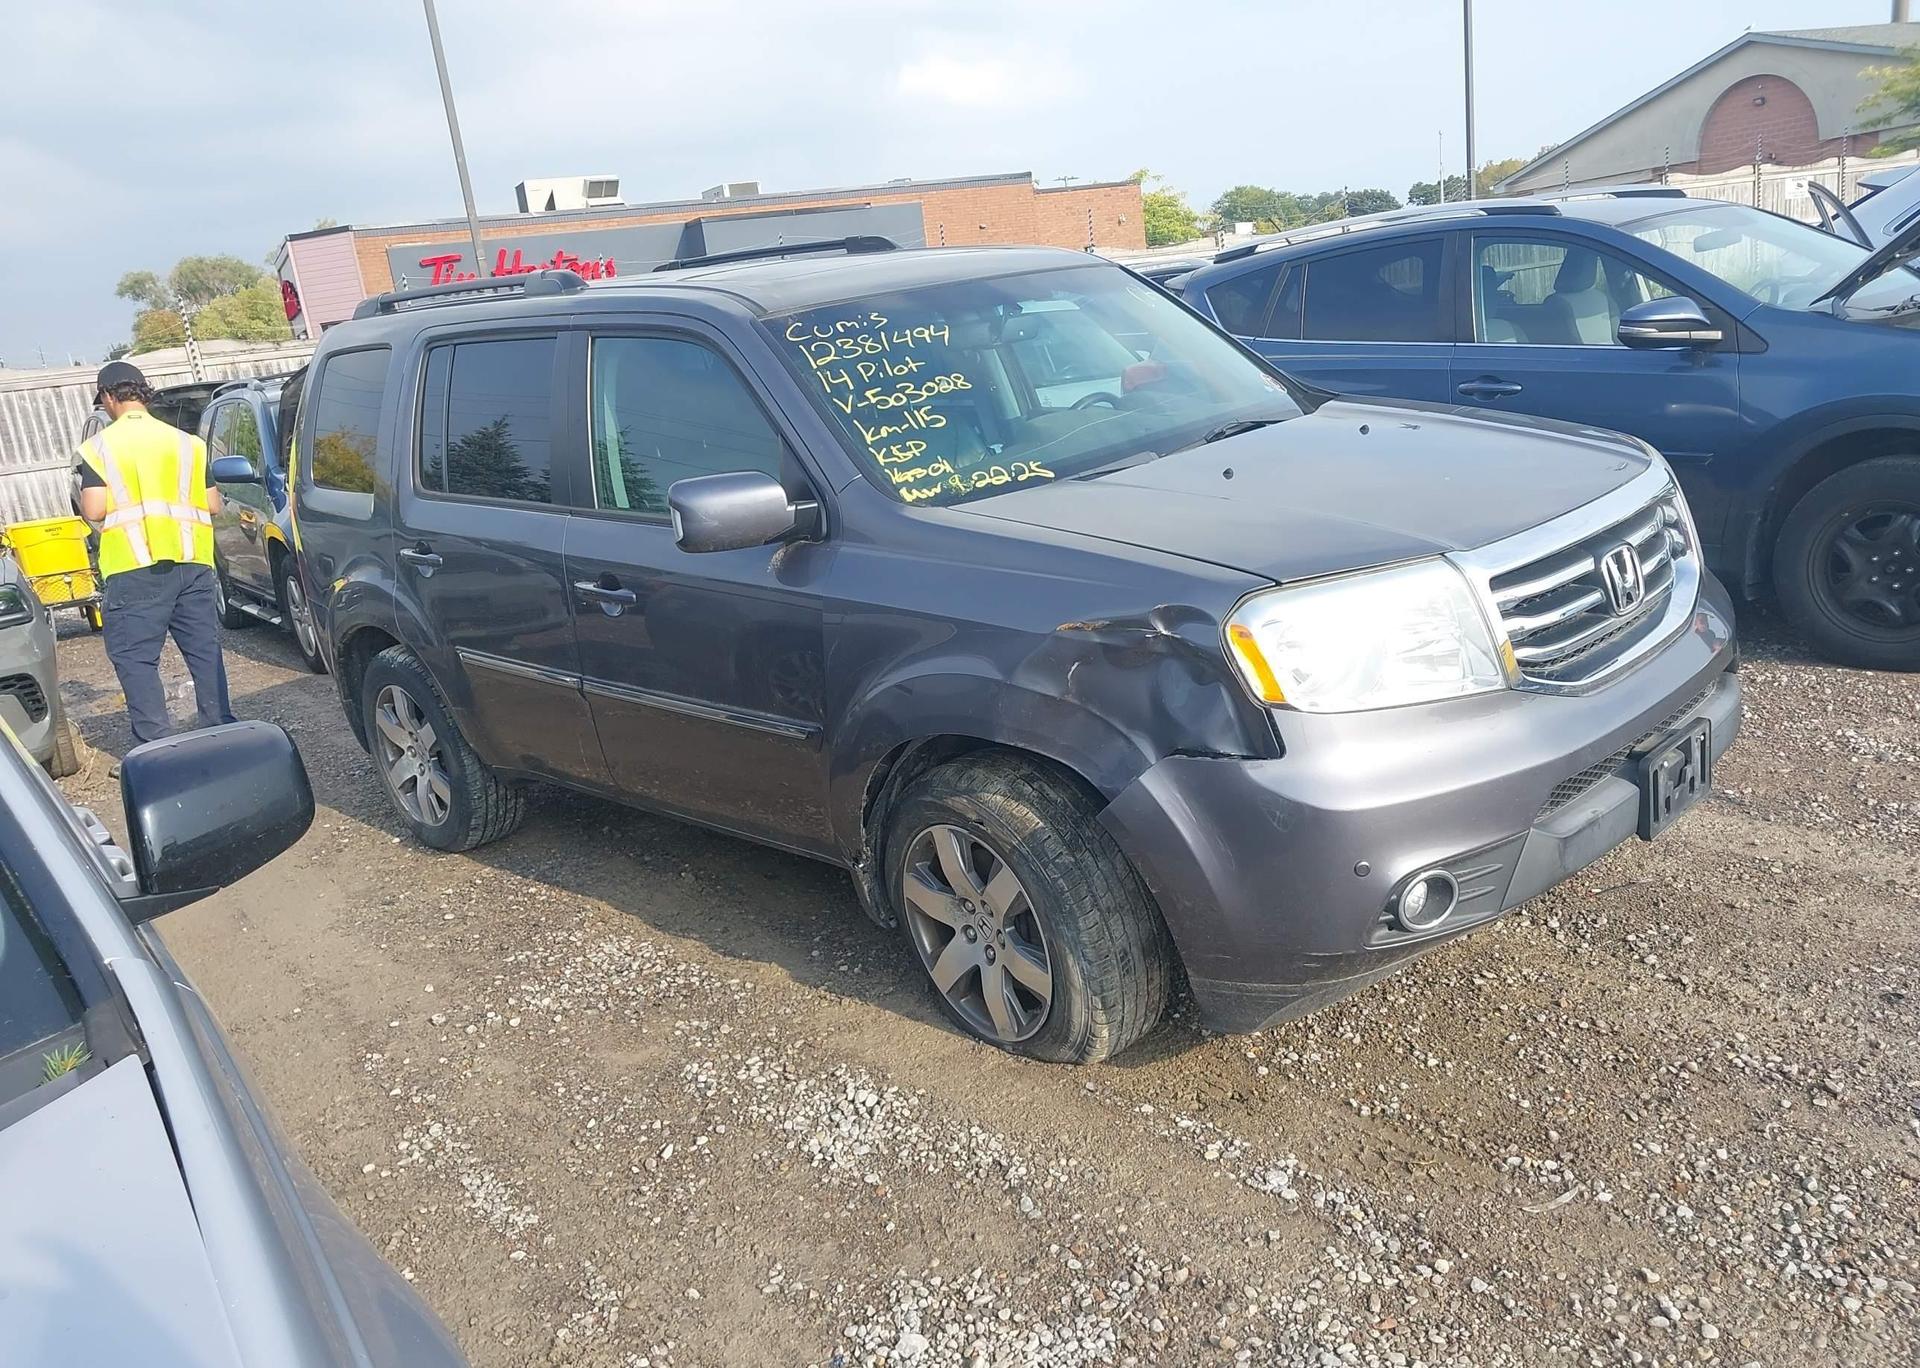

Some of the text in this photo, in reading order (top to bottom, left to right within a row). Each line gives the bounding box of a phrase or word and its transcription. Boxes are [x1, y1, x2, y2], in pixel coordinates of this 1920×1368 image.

[491, 247, 617, 280] Hotons
[799, 325, 950, 369] 12381494
[817, 356, 926, 393] 14 Pilot
